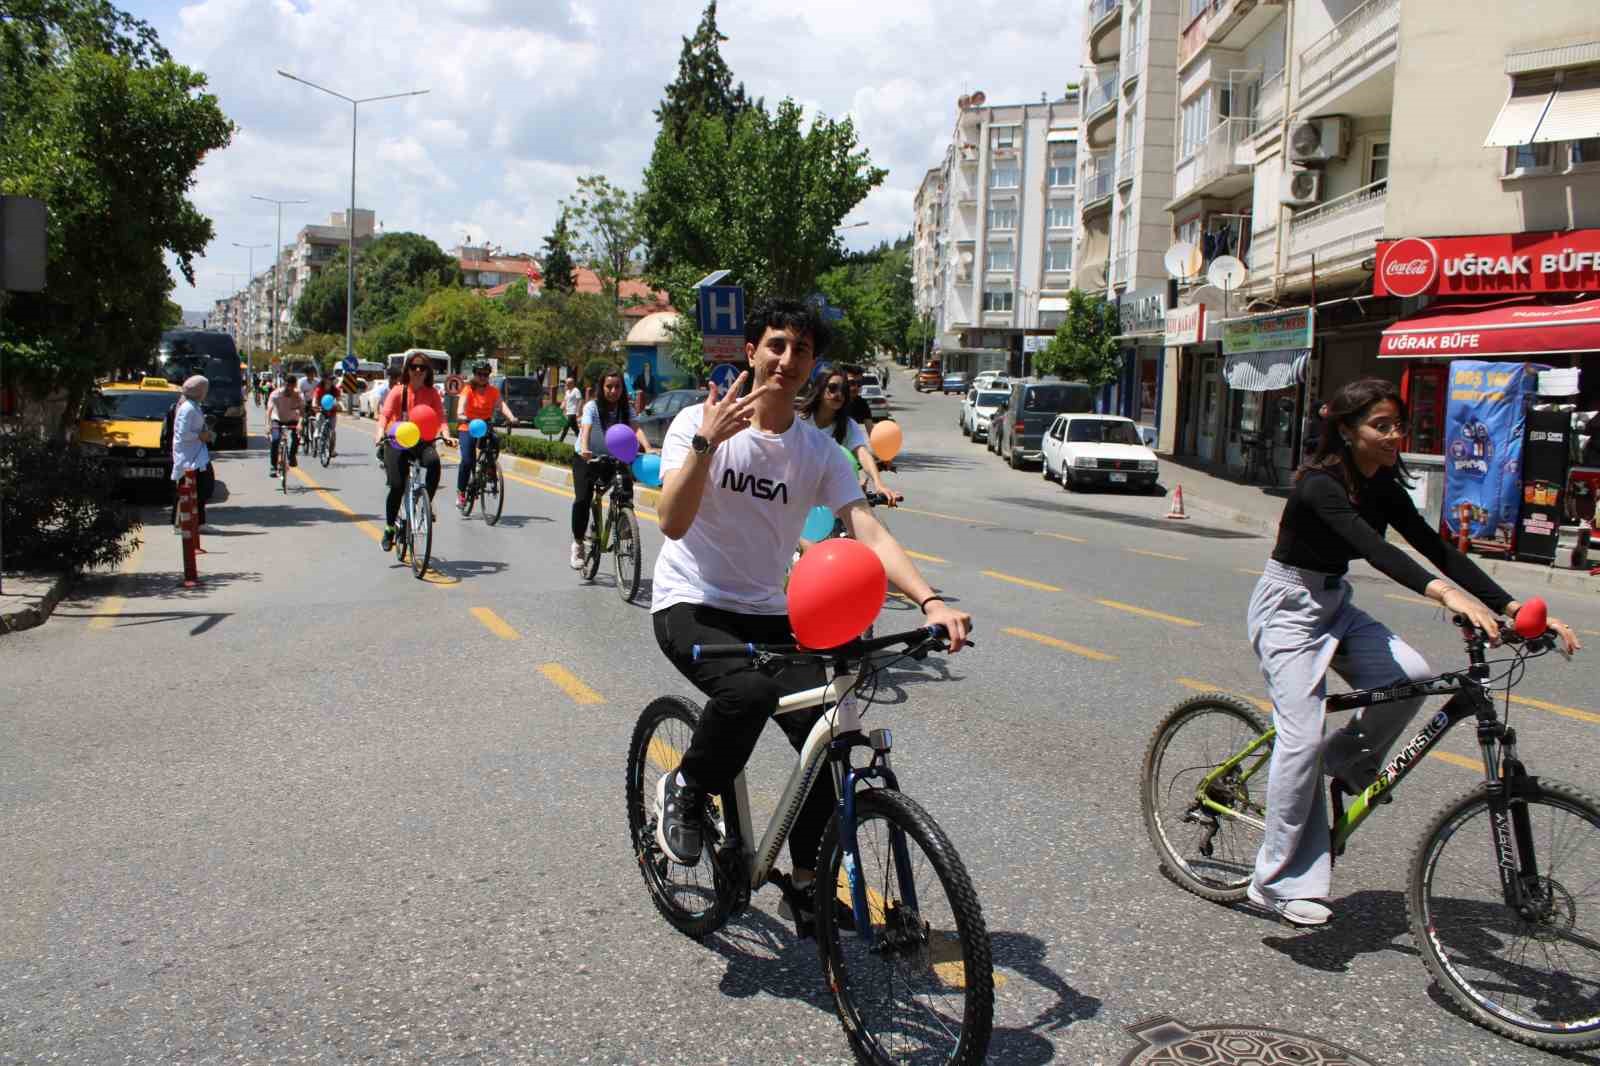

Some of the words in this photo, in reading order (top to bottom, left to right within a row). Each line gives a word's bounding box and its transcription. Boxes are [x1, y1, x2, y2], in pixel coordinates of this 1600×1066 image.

[1443, 253, 1530, 276] UĞRAK
[709, 292, 737, 330] H
[1387, 333, 1437, 350] UĞRAK
[1440, 332, 1480, 349] BÜFE
[720, 468, 788, 504] NASA
